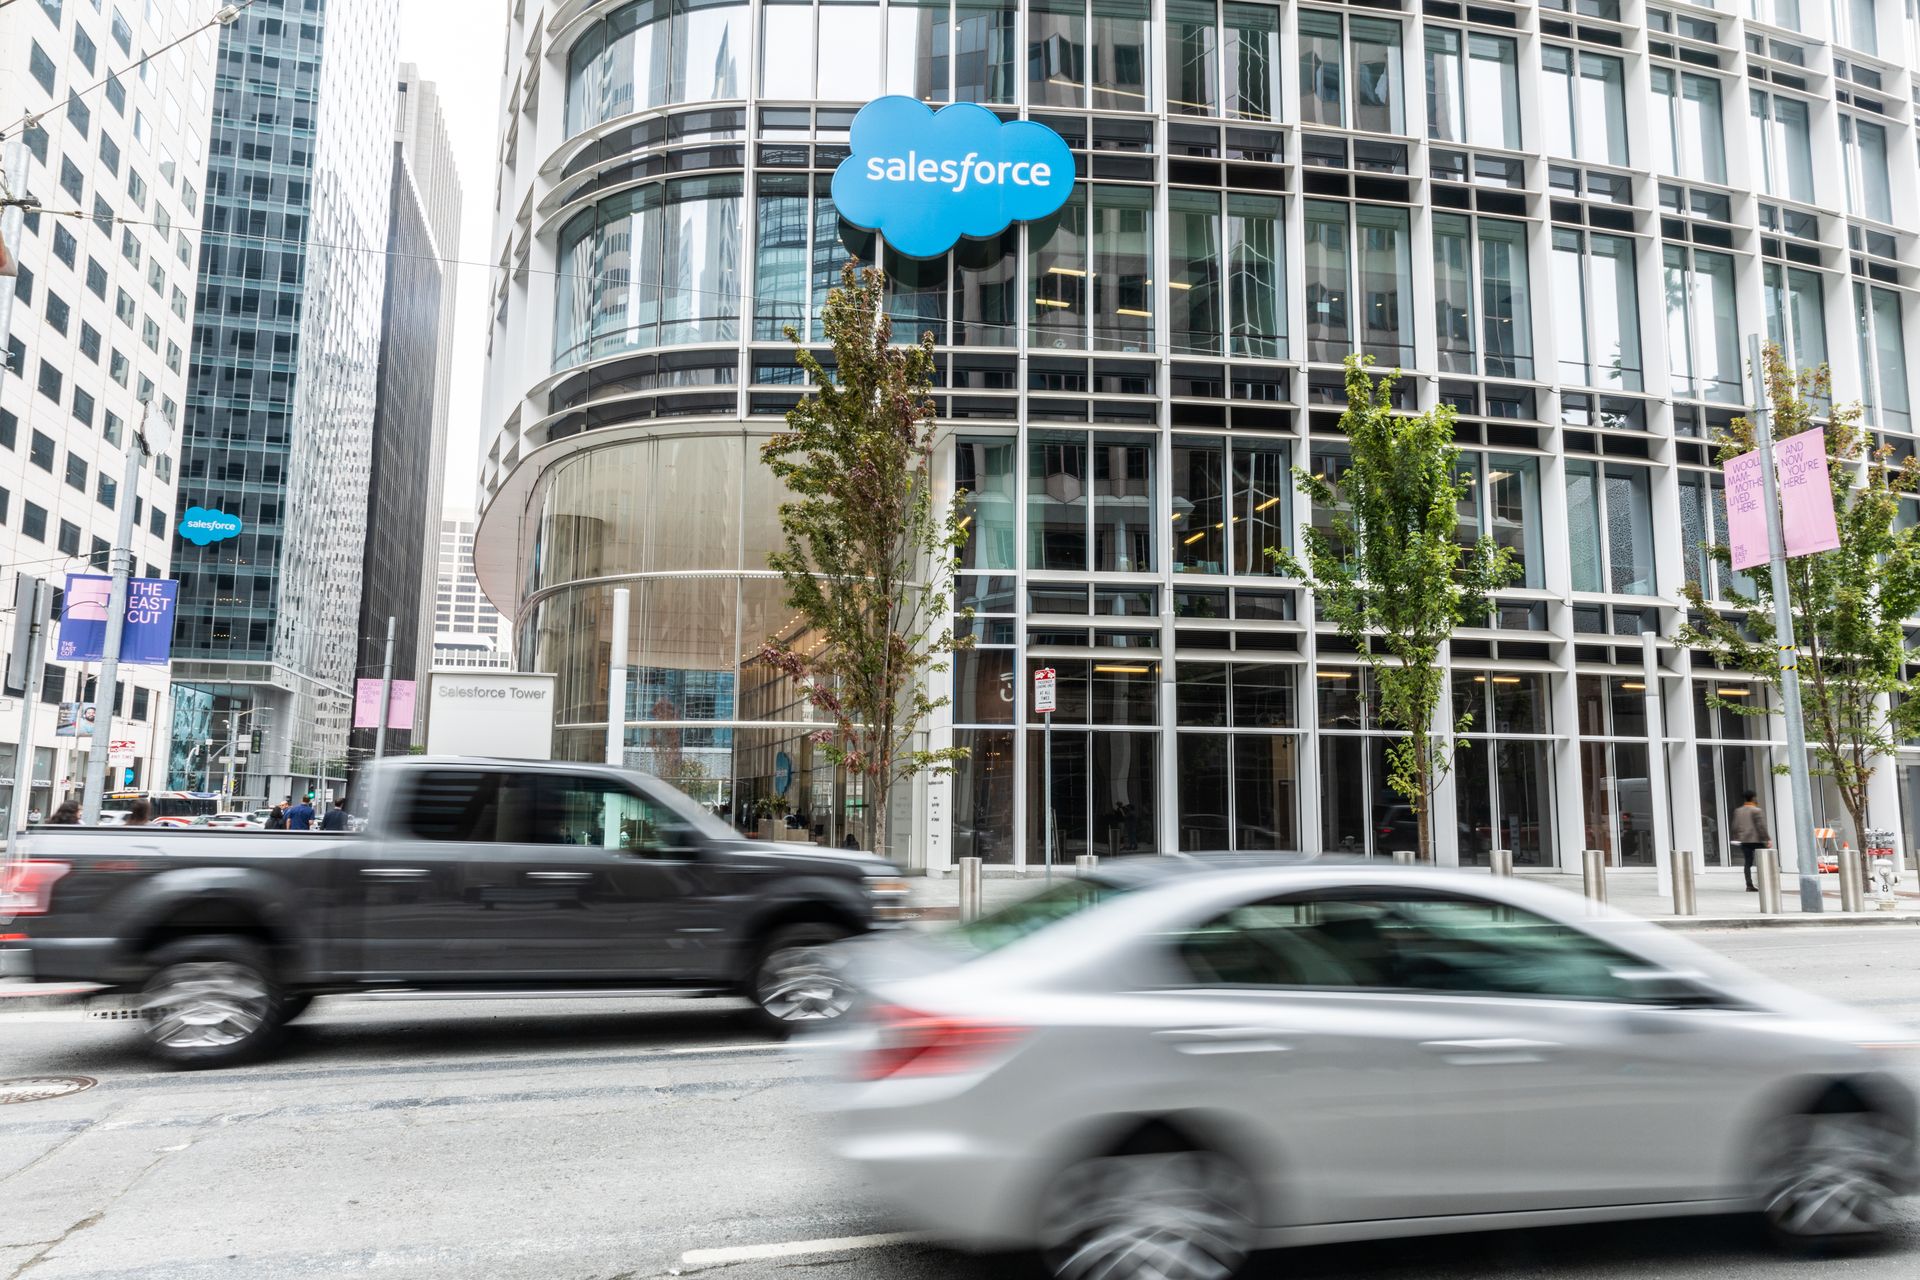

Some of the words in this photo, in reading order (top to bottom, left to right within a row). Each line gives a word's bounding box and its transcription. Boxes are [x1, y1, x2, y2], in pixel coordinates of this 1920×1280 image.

[867, 150, 1051, 192] salesforce
[1785, 441, 1804, 455] AND
[1733, 456, 1761, 473] WOOLL
[1781, 452, 1804, 468] NOW
[1787, 458, 1820, 475] YOU'RE
[1728, 471, 1751, 486] MAM-
[1735, 476, 1764, 494] MOTHS
[1783, 474, 1808, 488] HERE.
[1729, 491, 1750, 506] LIVED
[187, 520, 236, 531] salesforce
[130, 582, 163, 596] THE
[129, 596, 171, 611] EAST
[127, 610, 162, 624] CUT
[439, 686, 506, 698] Salesforce
[509, 687, 546, 699] Tower
[1882, 884, 1889, 893] 8
